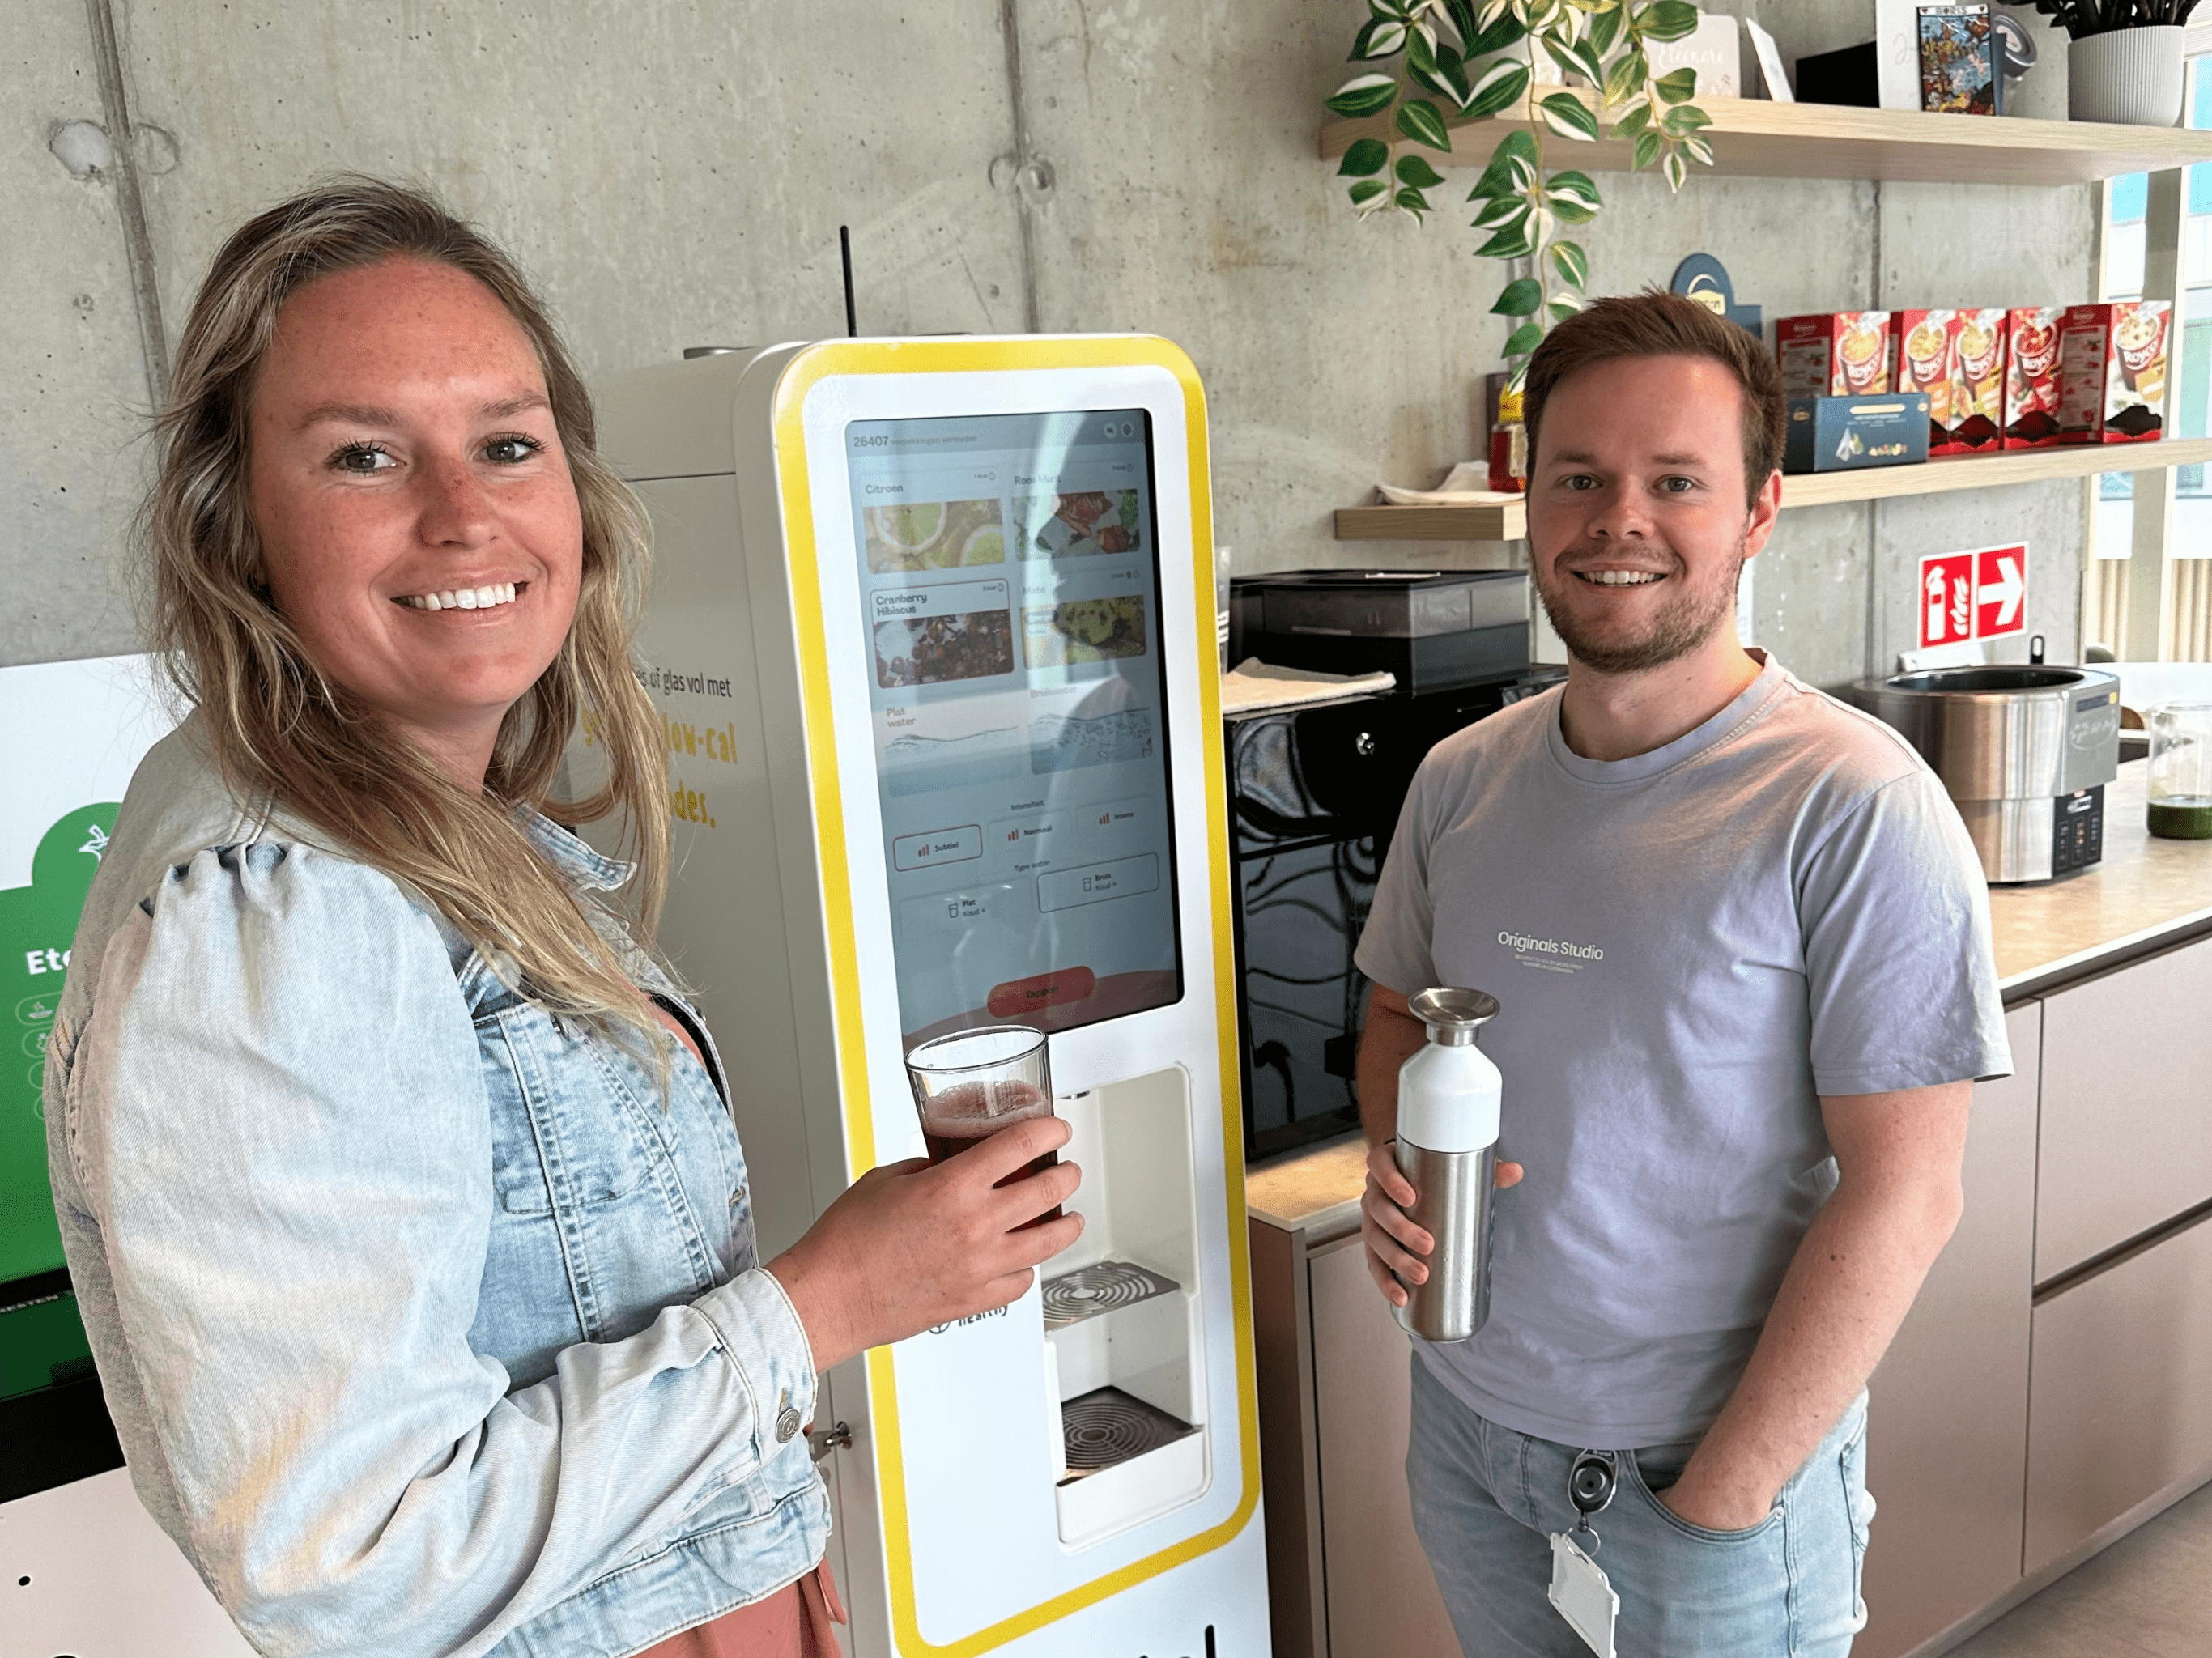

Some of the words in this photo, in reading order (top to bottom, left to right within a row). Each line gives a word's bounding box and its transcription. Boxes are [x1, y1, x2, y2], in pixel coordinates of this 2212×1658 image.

[853, 436, 889, 447] 26407
[866, 484, 904, 494] Citroen
[876, 594, 928, 606] Cranberry
[877, 606, 917, 617] Hibiscus
[664, 669, 685, 696] glas
[687, 672, 706, 695] vol
[708, 678, 732, 698] met
[887, 708, 905, 717] Plat
[887, 717, 916, 729] water
[661, 712, 738, 764] low-cal
[934, 842, 959, 852] Subtiel
[1498, 931, 1559, 953] Originals
[1560, 941, 1604, 960] Studio
